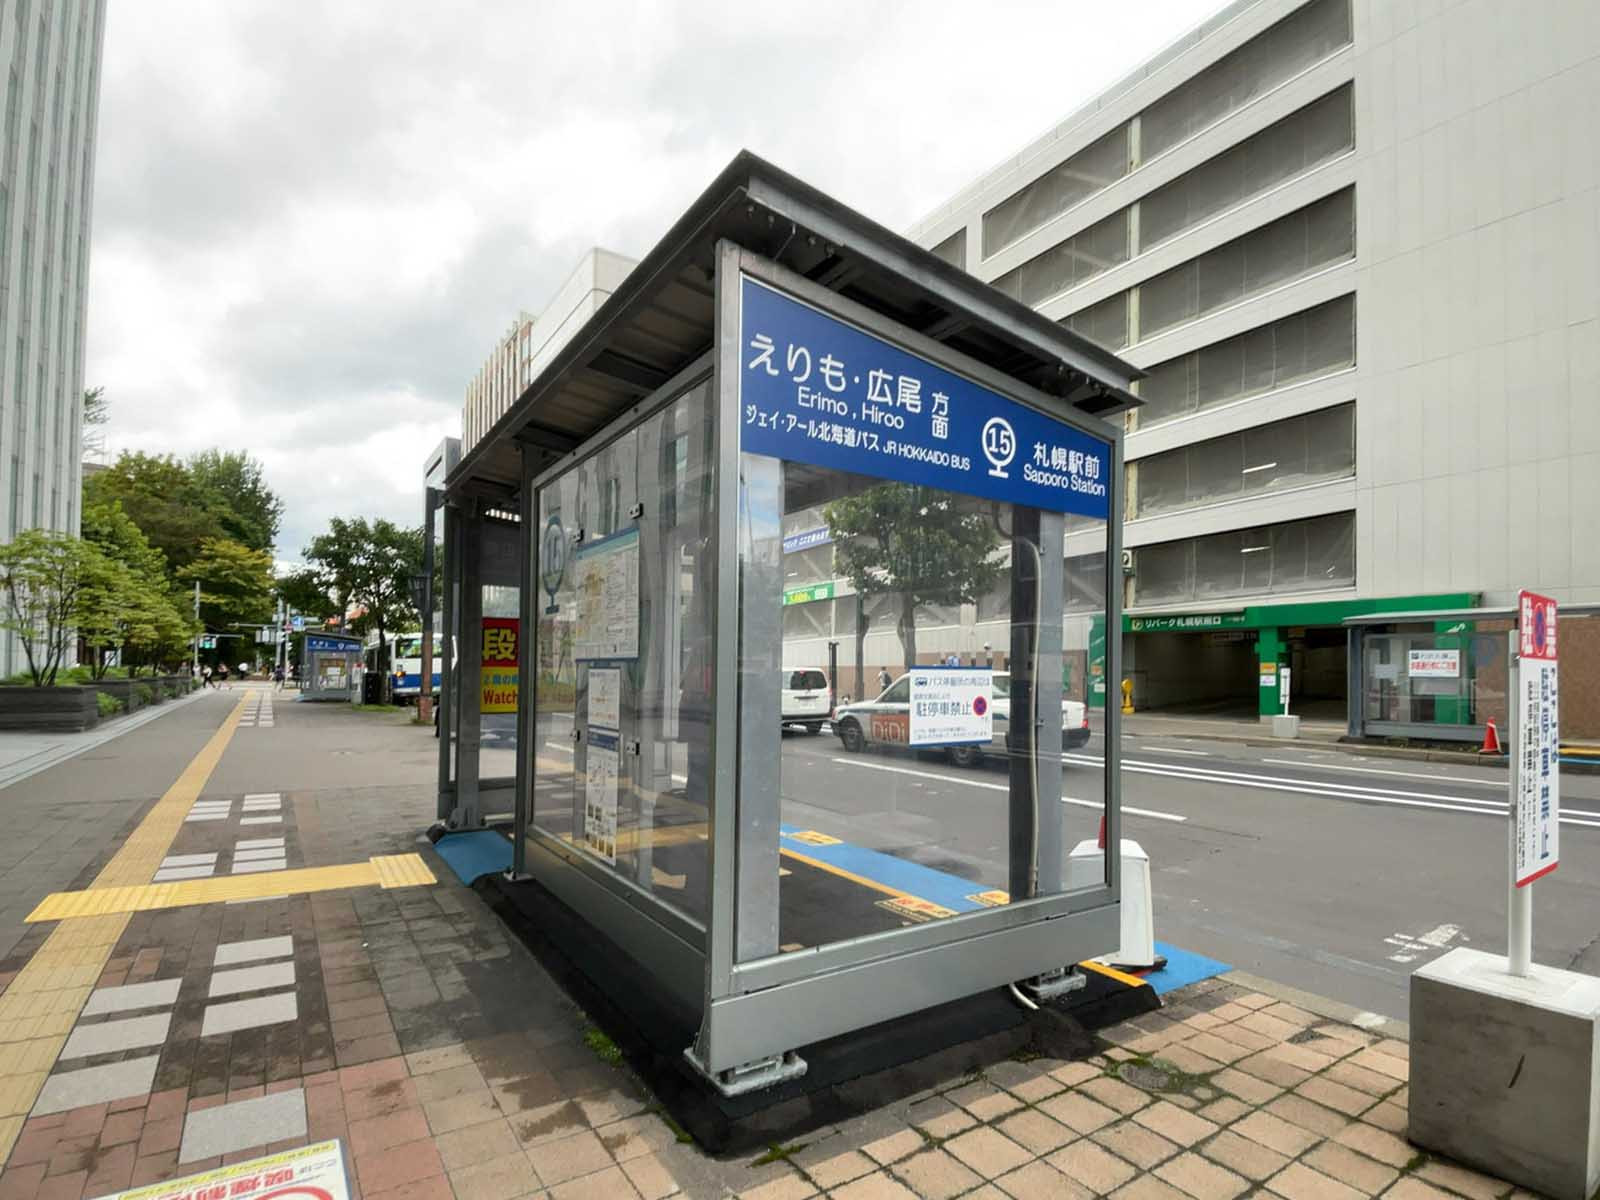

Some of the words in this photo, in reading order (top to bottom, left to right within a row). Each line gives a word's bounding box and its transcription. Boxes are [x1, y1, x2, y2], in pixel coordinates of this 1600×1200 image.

[748, 333, 922, 414] えりも・広尾
[862, 402, 905, 430] Hiroo
[931, 392, 950, 440] 方面
[883, 440, 897, 455] JR
[898, 443, 950, 466] HOKKAIDO
[950, 455, 971, 471] BUS
[988, 428, 1011, 456] 15
[1033, 441, 1101, 480] 札幌駅前
[1023, 463, 1069, 489] Sapporo
[1070, 474, 1106, 497] Station
[916, 701, 972, 717] 駐停車禁止
[872, 720, 905, 742] DiDi
